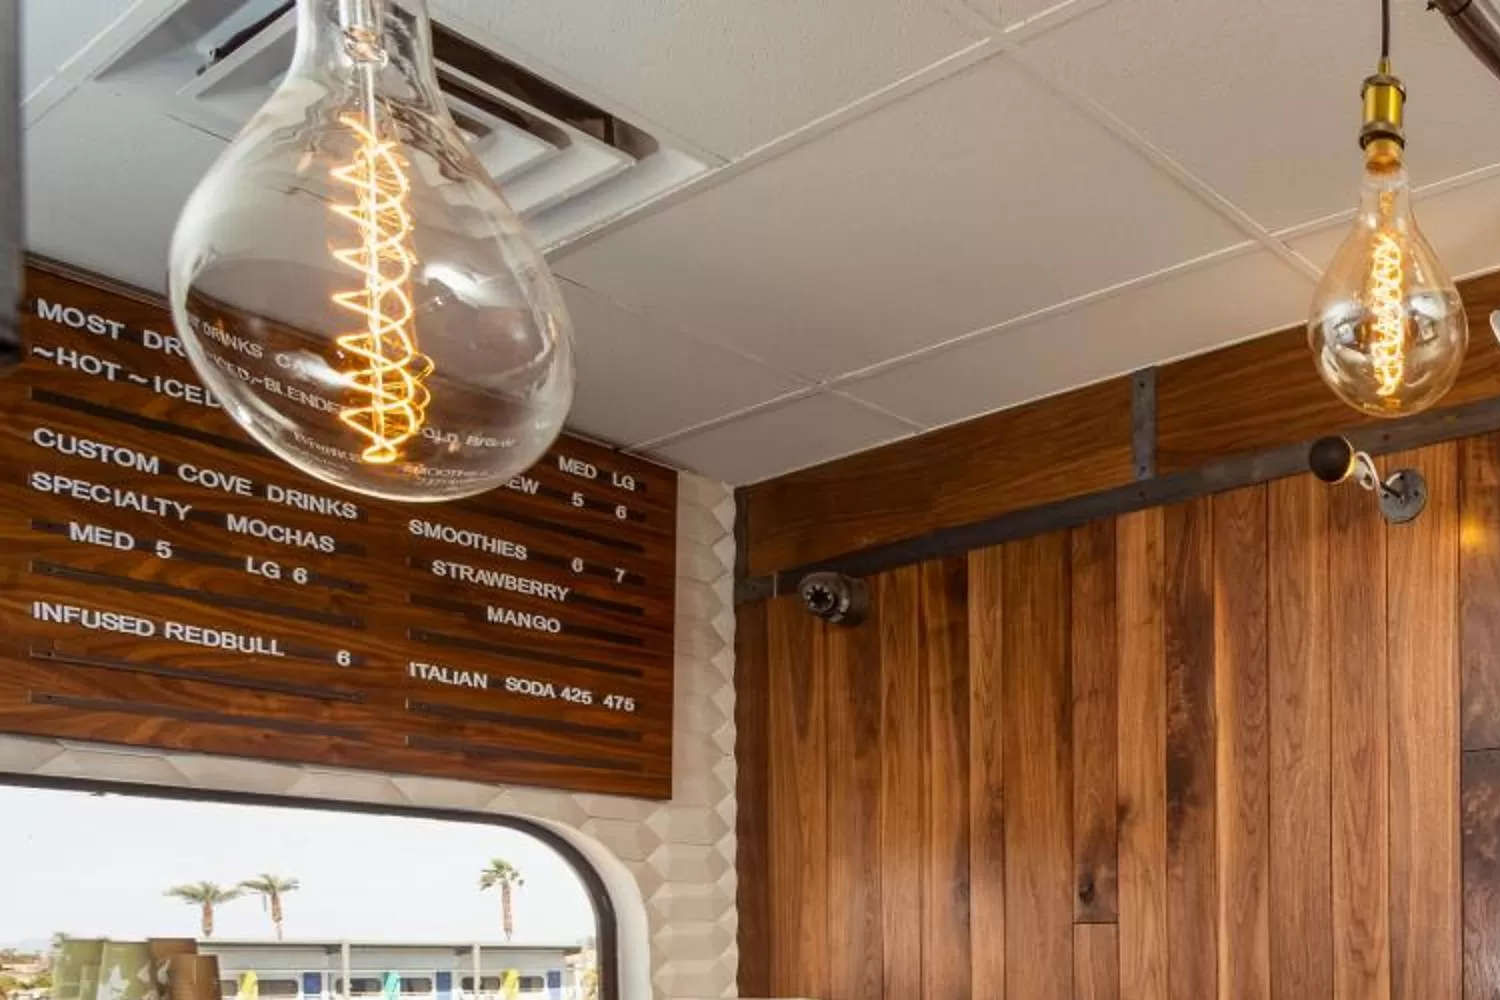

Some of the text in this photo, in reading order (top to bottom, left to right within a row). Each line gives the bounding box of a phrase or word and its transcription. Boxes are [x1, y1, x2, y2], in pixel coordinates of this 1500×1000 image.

[37, 298, 125, 342] MOST
[32, 426, 359, 521] CUSTOM COVE DRINKS
[558, 454, 636, 492] MED LG
[31, 471, 336, 554] SPECIALTY MOCHAS
[571, 491, 585, 508] 5
[615, 505, 628, 520] 6
[68, 521, 309, 585] MED 5 LG 6
[408, 518, 626, 583] SMOOTHIES 6 7
[431, 559, 570, 602] STRAWBERRY
[32, 601, 351, 667] INFUSED REDBULL 6
[486, 605, 562, 634] MANGO
[409, 661, 636, 713] ITALIAN SODA 425 475
